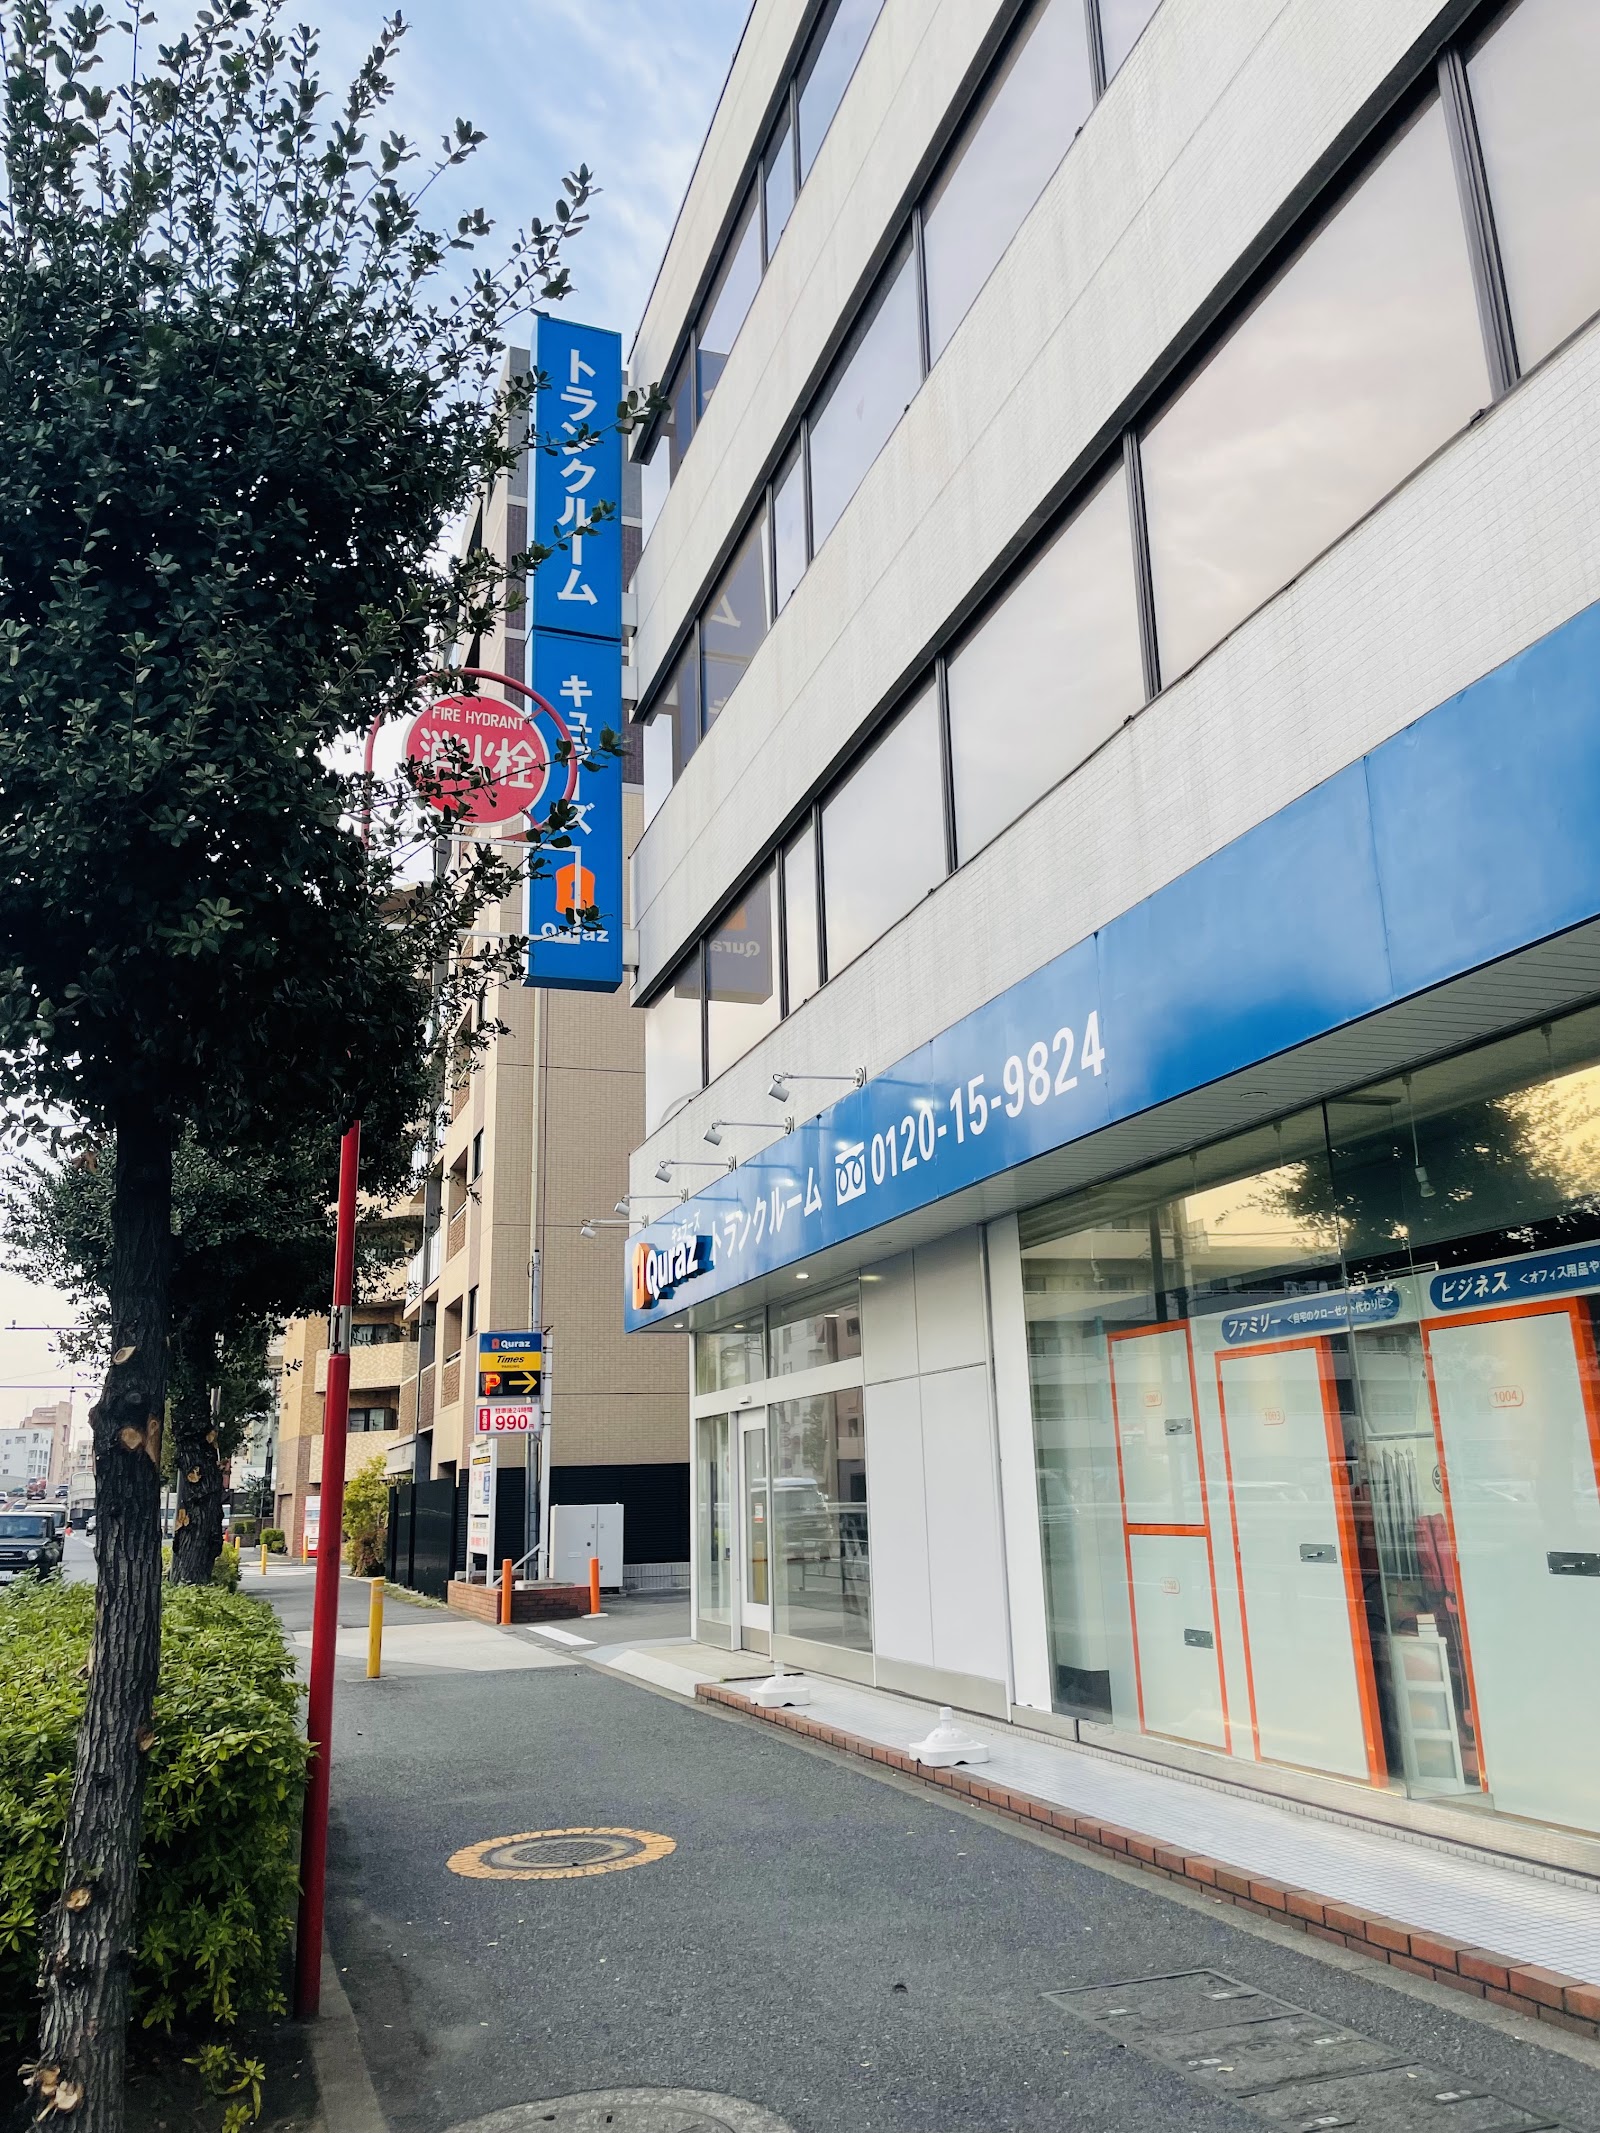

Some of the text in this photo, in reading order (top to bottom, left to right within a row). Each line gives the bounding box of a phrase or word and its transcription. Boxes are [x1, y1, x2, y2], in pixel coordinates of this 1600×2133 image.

[557, 349, 598, 605] トランクルーム
[432, 706, 525, 731] FIRE HYDRANT
[420, 727, 537, 789] 消火栓
[871, 1010, 1105, 1185] 0120-15-9824
[710, 1166, 823, 1267] トランクルーム
[646, 1235, 699, 1301] Quraz
[1441, 1271, 1511, 1304] ビジネス
[1228, 1313, 1282, 1339] ファミリー
[501, 1340, 531, 1349] Quraz
[497, 1355, 525, 1364] Times
[485, 1371, 501, 1396] P
[1494, 1390, 1518, 1403] 1004
